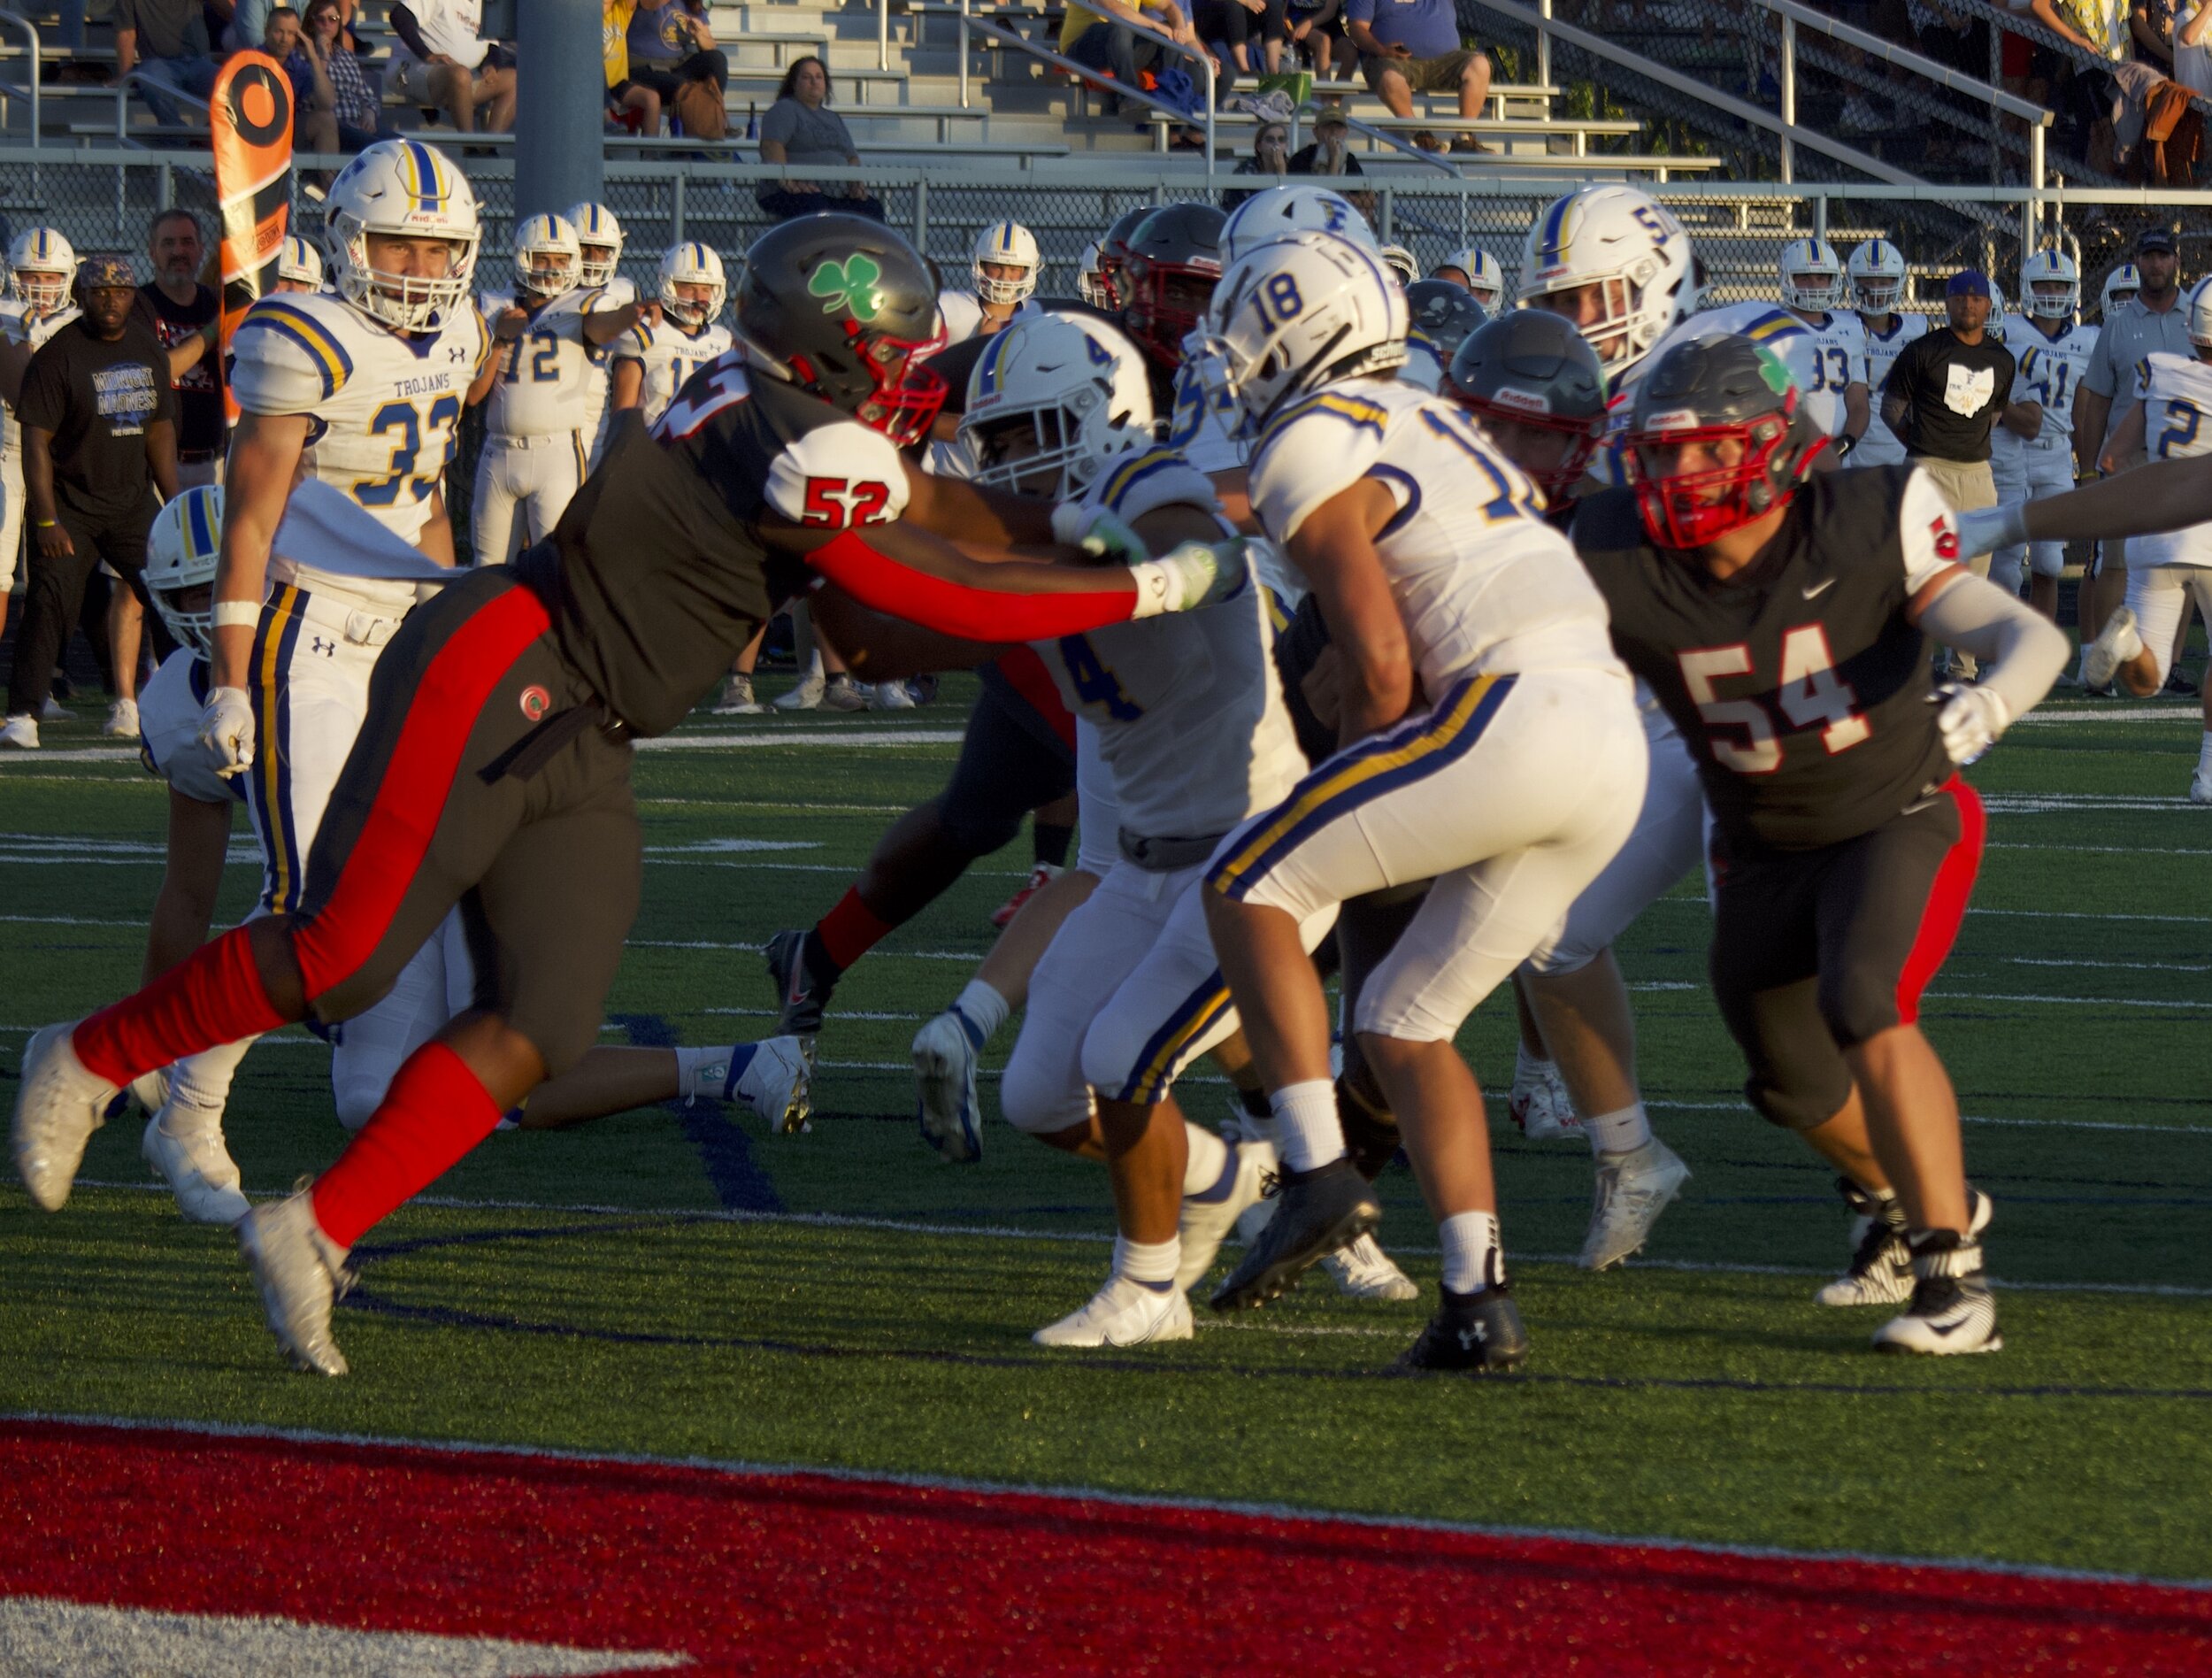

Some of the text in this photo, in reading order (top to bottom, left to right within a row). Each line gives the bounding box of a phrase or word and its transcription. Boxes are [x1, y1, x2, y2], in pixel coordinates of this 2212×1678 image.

[1250, 272, 1304, 338] 18
[92, 367, 155, 392] MIDNIGHT
[395, 373, 450, 397] TROJANS
[1500, 389, 1544, 409] Riddell
[98, 389, 157, 415] MADNESS
[349, 390, 461, 510] 33
[801, 475, 890, 531] 52
[1674, 620, 1872, 777] 54
